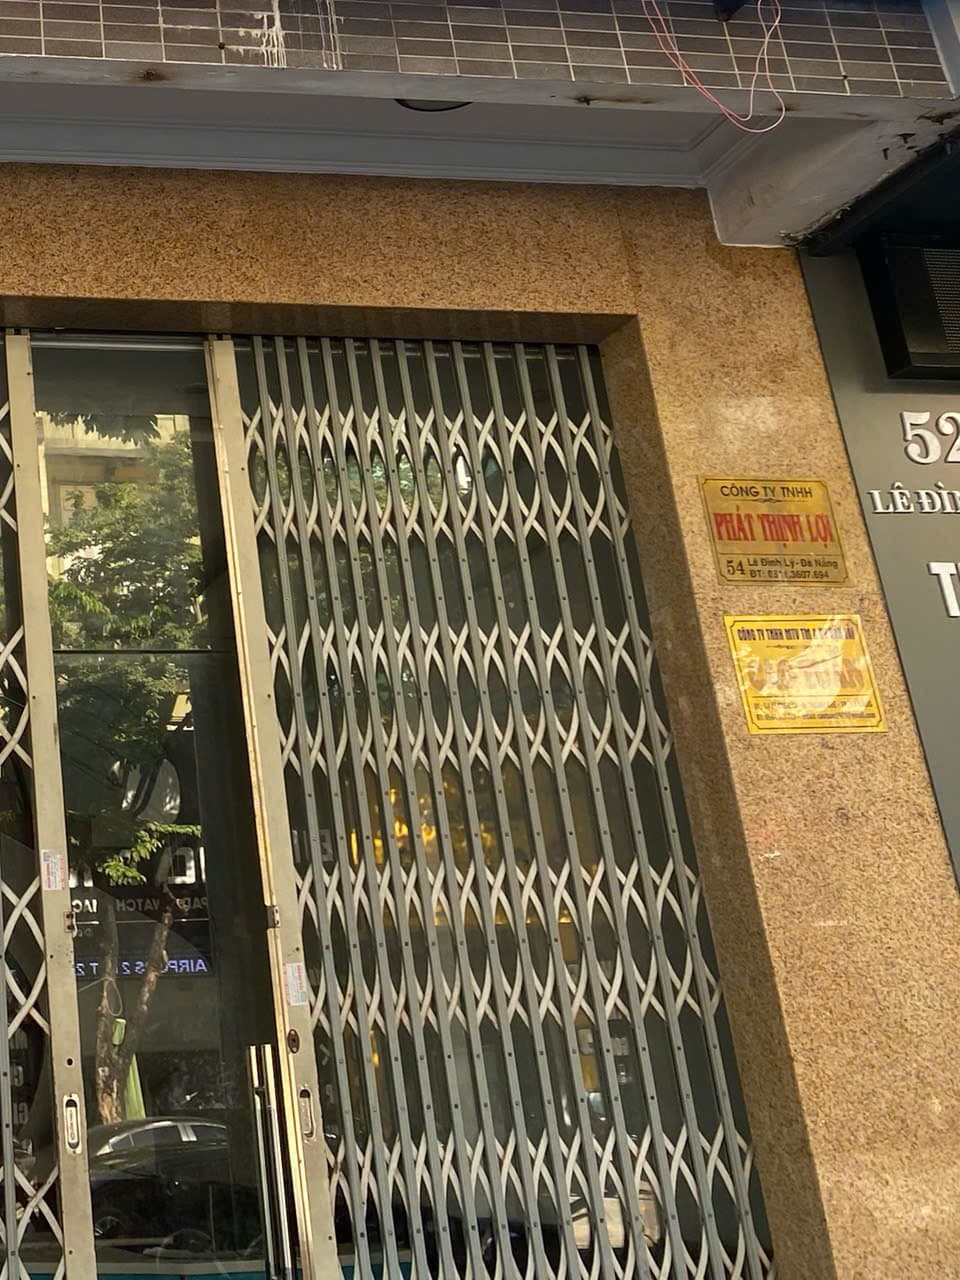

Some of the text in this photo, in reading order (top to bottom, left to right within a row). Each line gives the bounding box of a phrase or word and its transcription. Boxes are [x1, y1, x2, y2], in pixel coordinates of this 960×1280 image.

[720, 483, 813, 498] CÔNG TY TNHH
[868, 481, 915, 514] LÊ
[713, 504, 757, 541] PHÁT
[757, 513, 805, 549] THỊNH
[726, 559, 746, 576] 54
